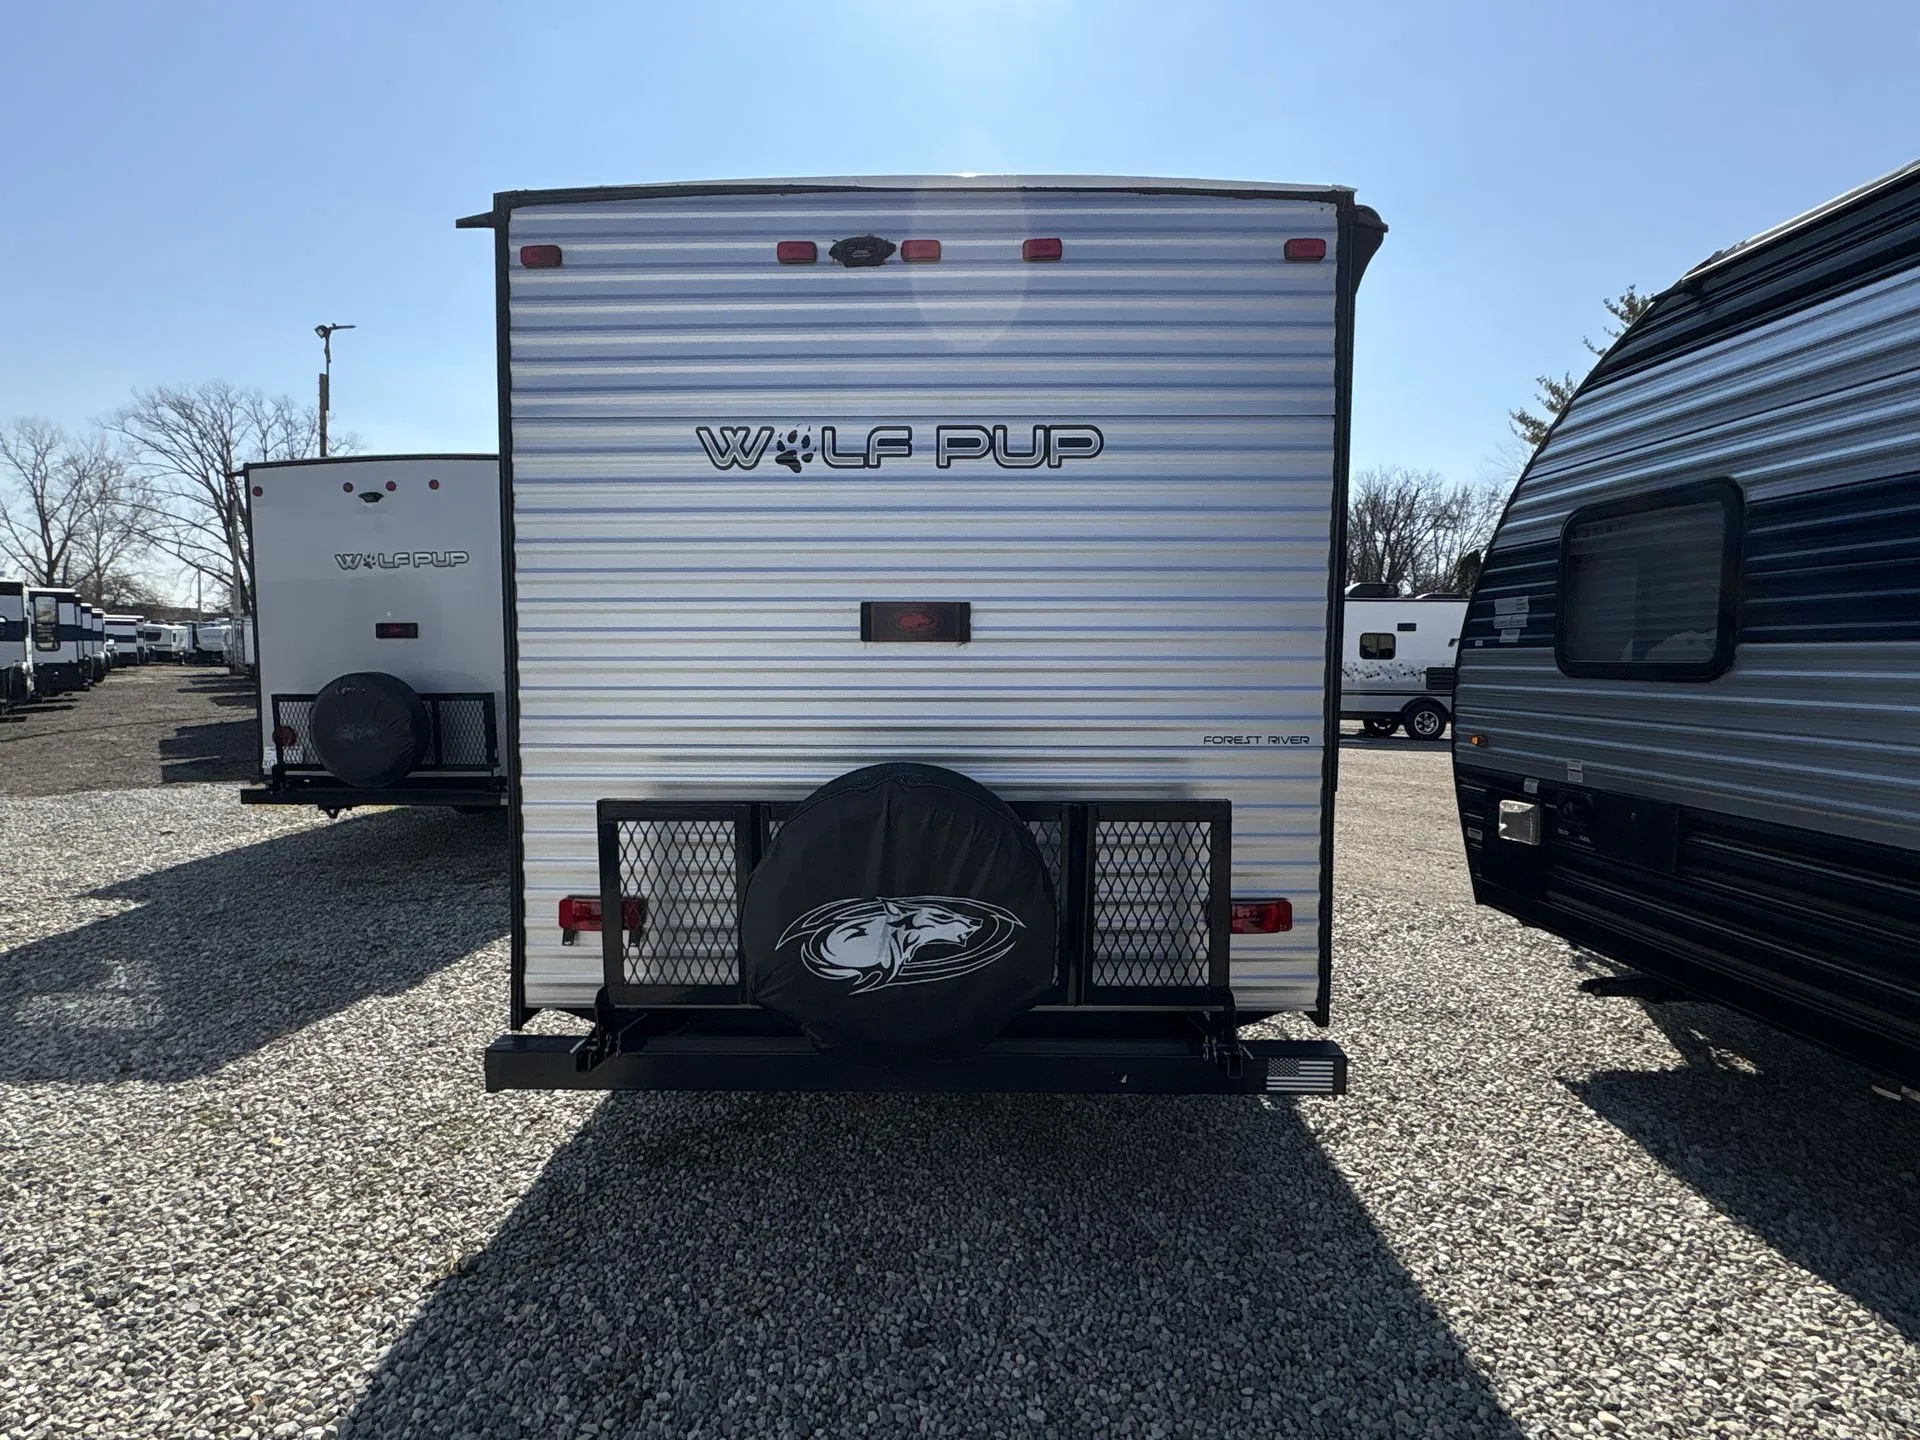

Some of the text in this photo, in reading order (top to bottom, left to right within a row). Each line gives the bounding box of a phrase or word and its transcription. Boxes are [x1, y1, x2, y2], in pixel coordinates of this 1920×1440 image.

[936, 425, 1104, 469] PUP
[413, 551, 470, 568] PUP
[1203, 735, 1310, 745] FOREST RIVER
